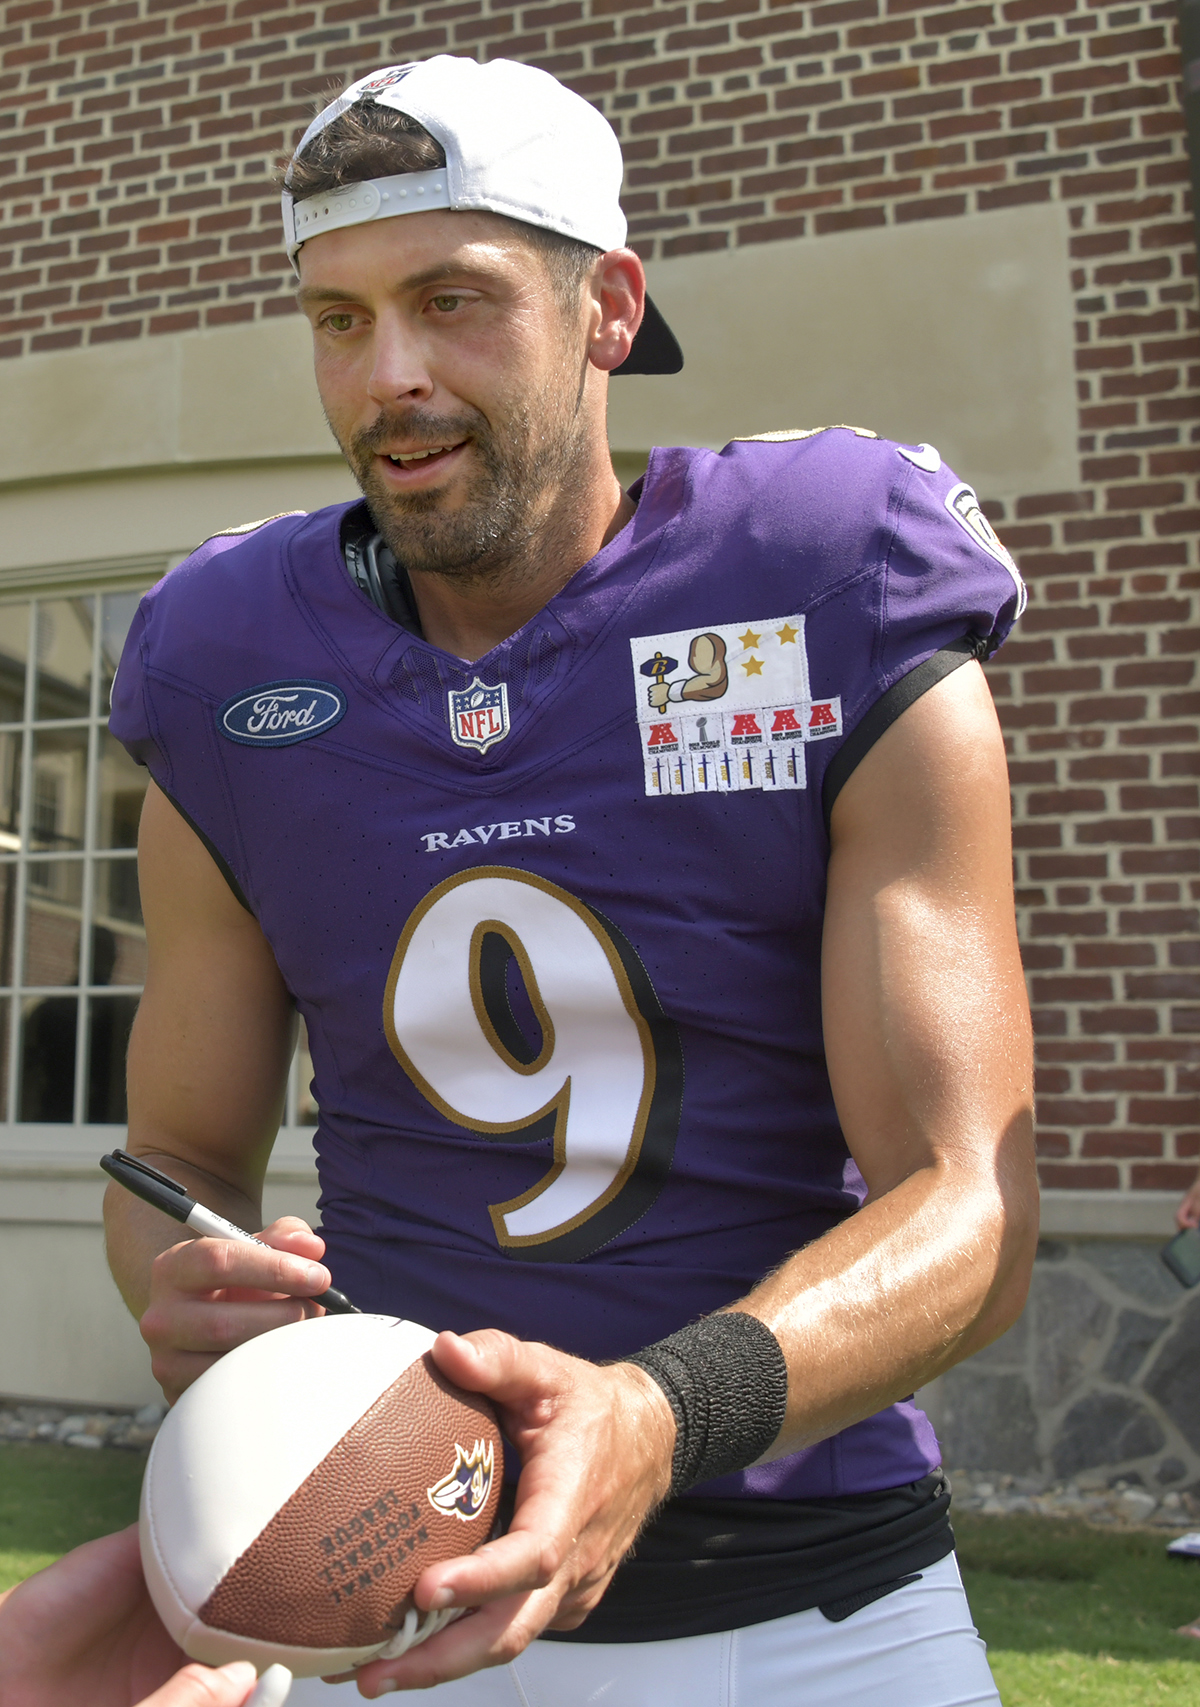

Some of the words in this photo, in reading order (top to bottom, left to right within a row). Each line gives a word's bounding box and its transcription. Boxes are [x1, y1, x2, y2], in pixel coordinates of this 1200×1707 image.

[247, 694, 319, 733] Ford
[458, 708, 501, 739] NFL
[420, 814, 577, 852] RAVENS
[383, 865, 684, 1263] 9
[320, 1489, 399, 1555] LEAGUE
